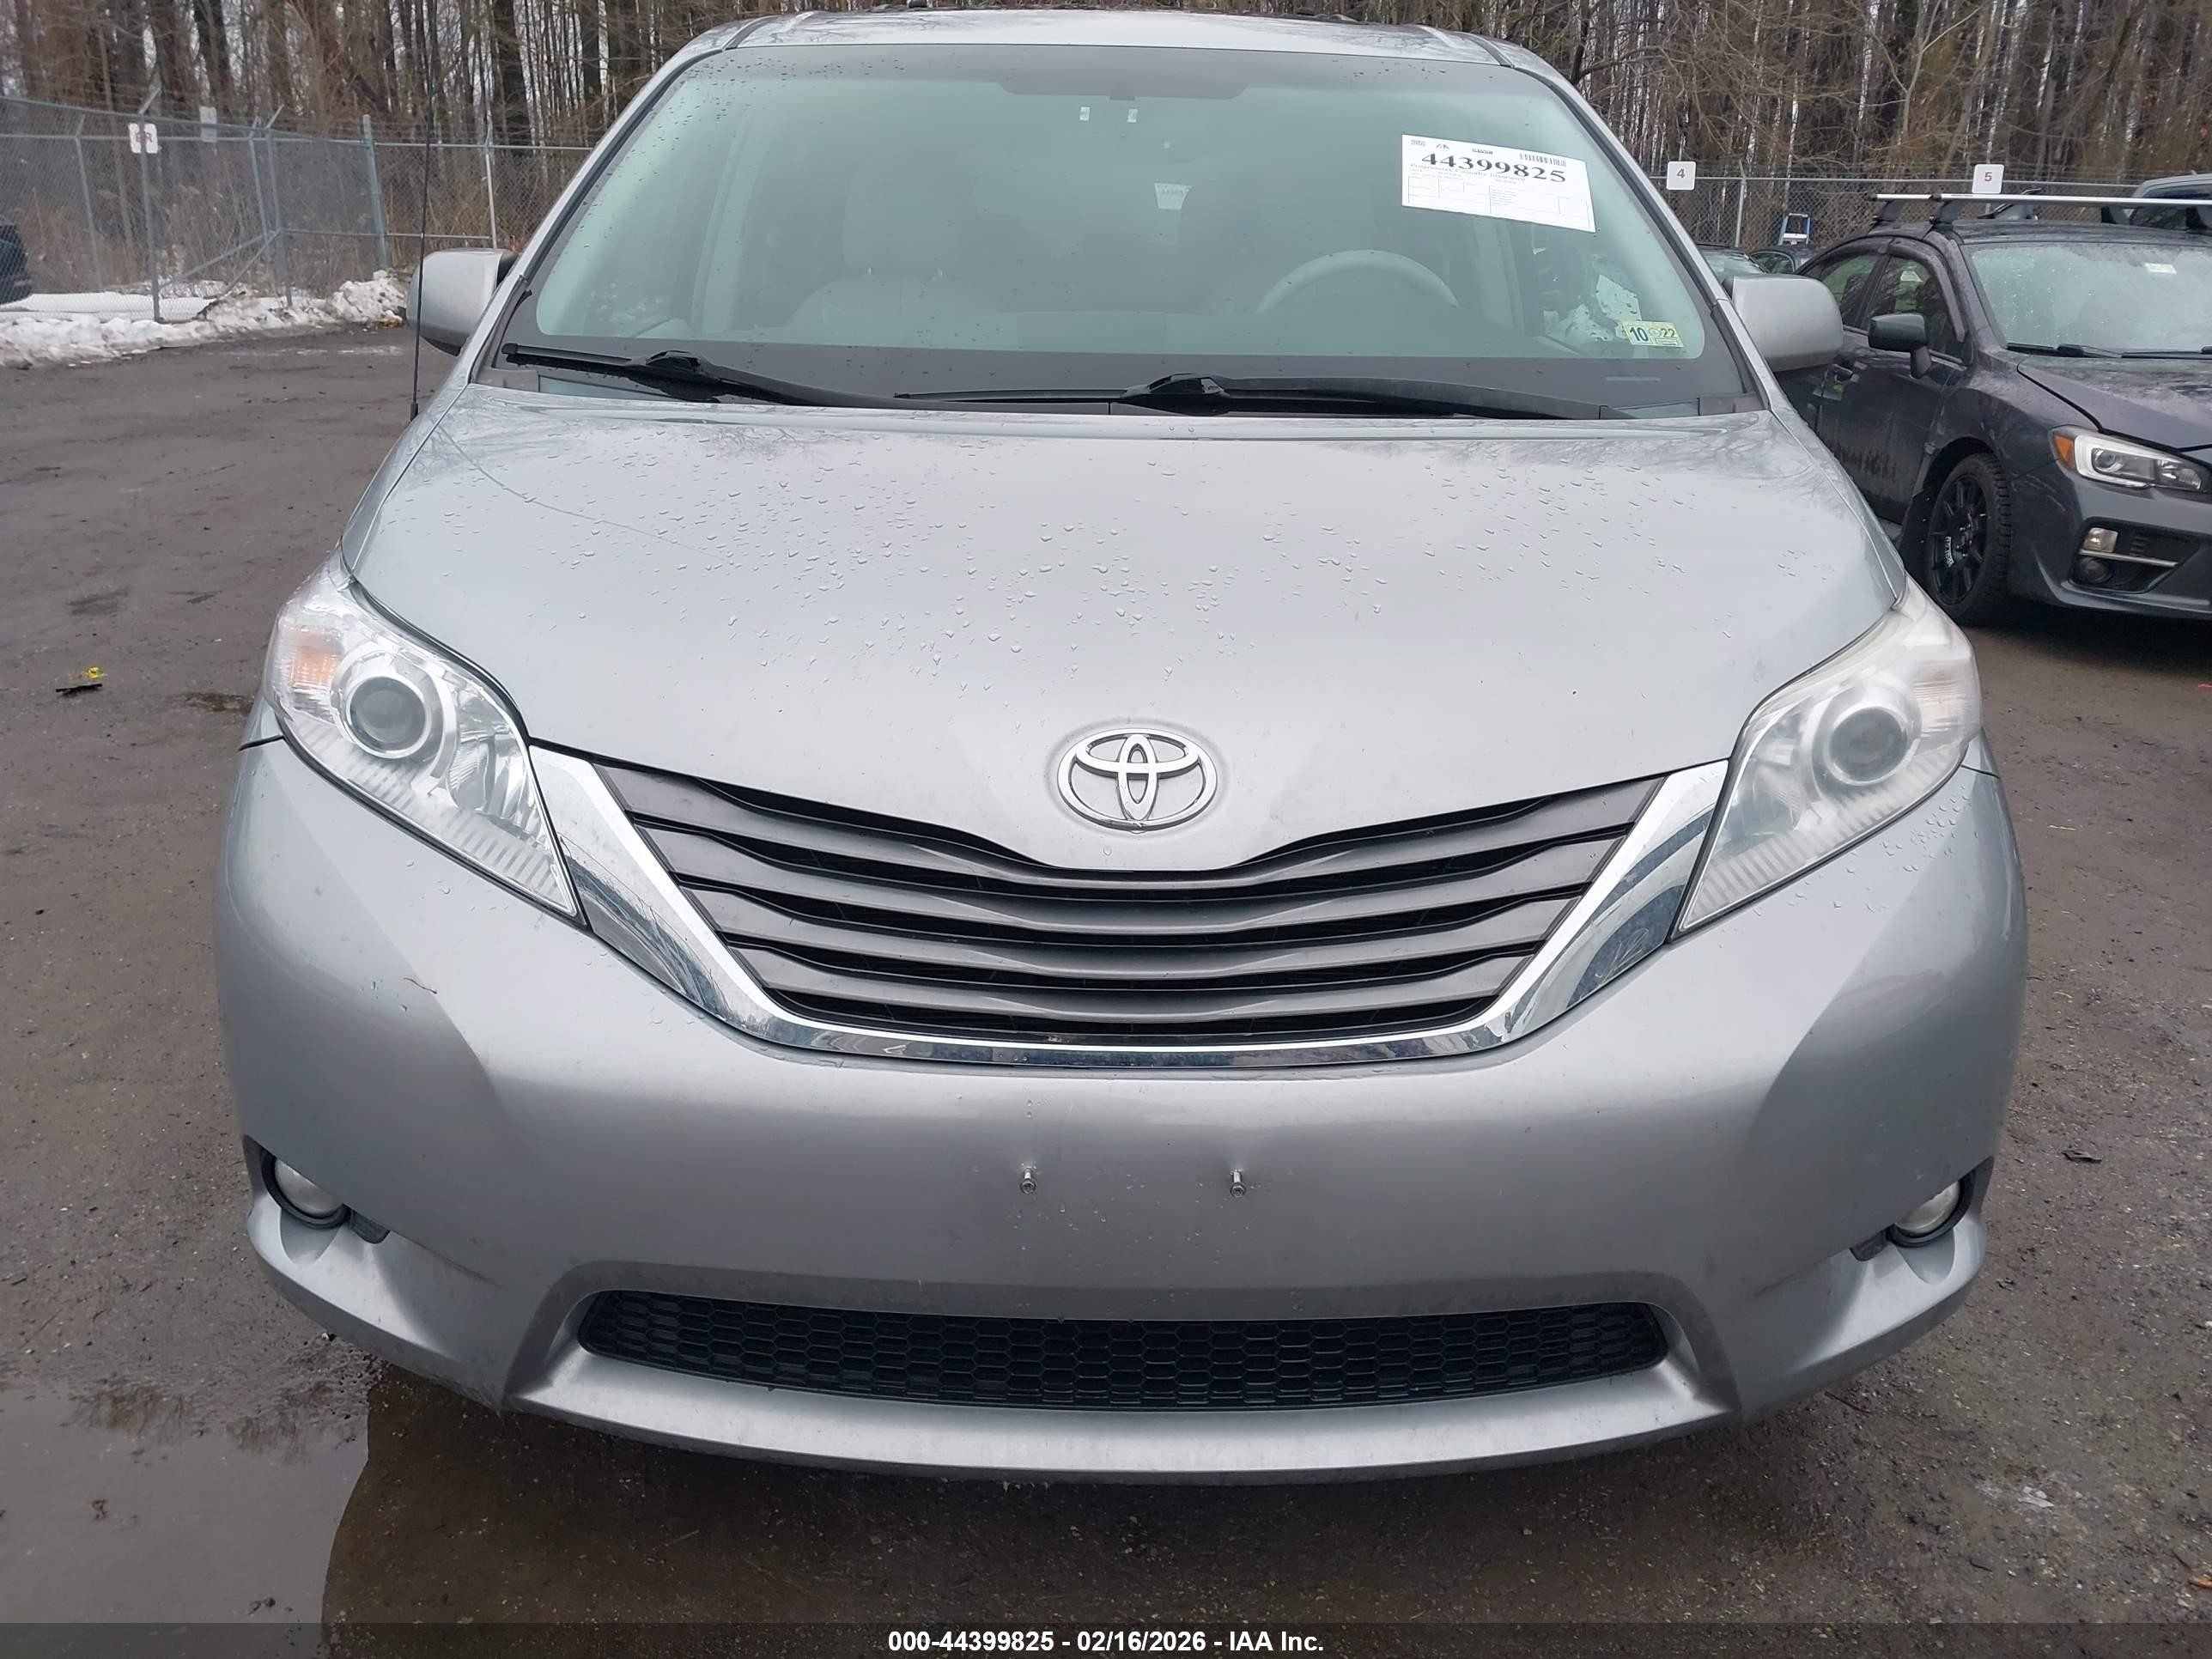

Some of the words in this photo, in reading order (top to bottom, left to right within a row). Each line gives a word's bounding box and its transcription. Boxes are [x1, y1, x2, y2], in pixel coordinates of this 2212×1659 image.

[1421, 153, 1566, 183] 44399825
[1676, 167, 1686, 179] 4
[1984, 171, 1993, 182] 5
[1629, 327, 1649, 342] 10
[1661, 328, 1676, 338] 22
